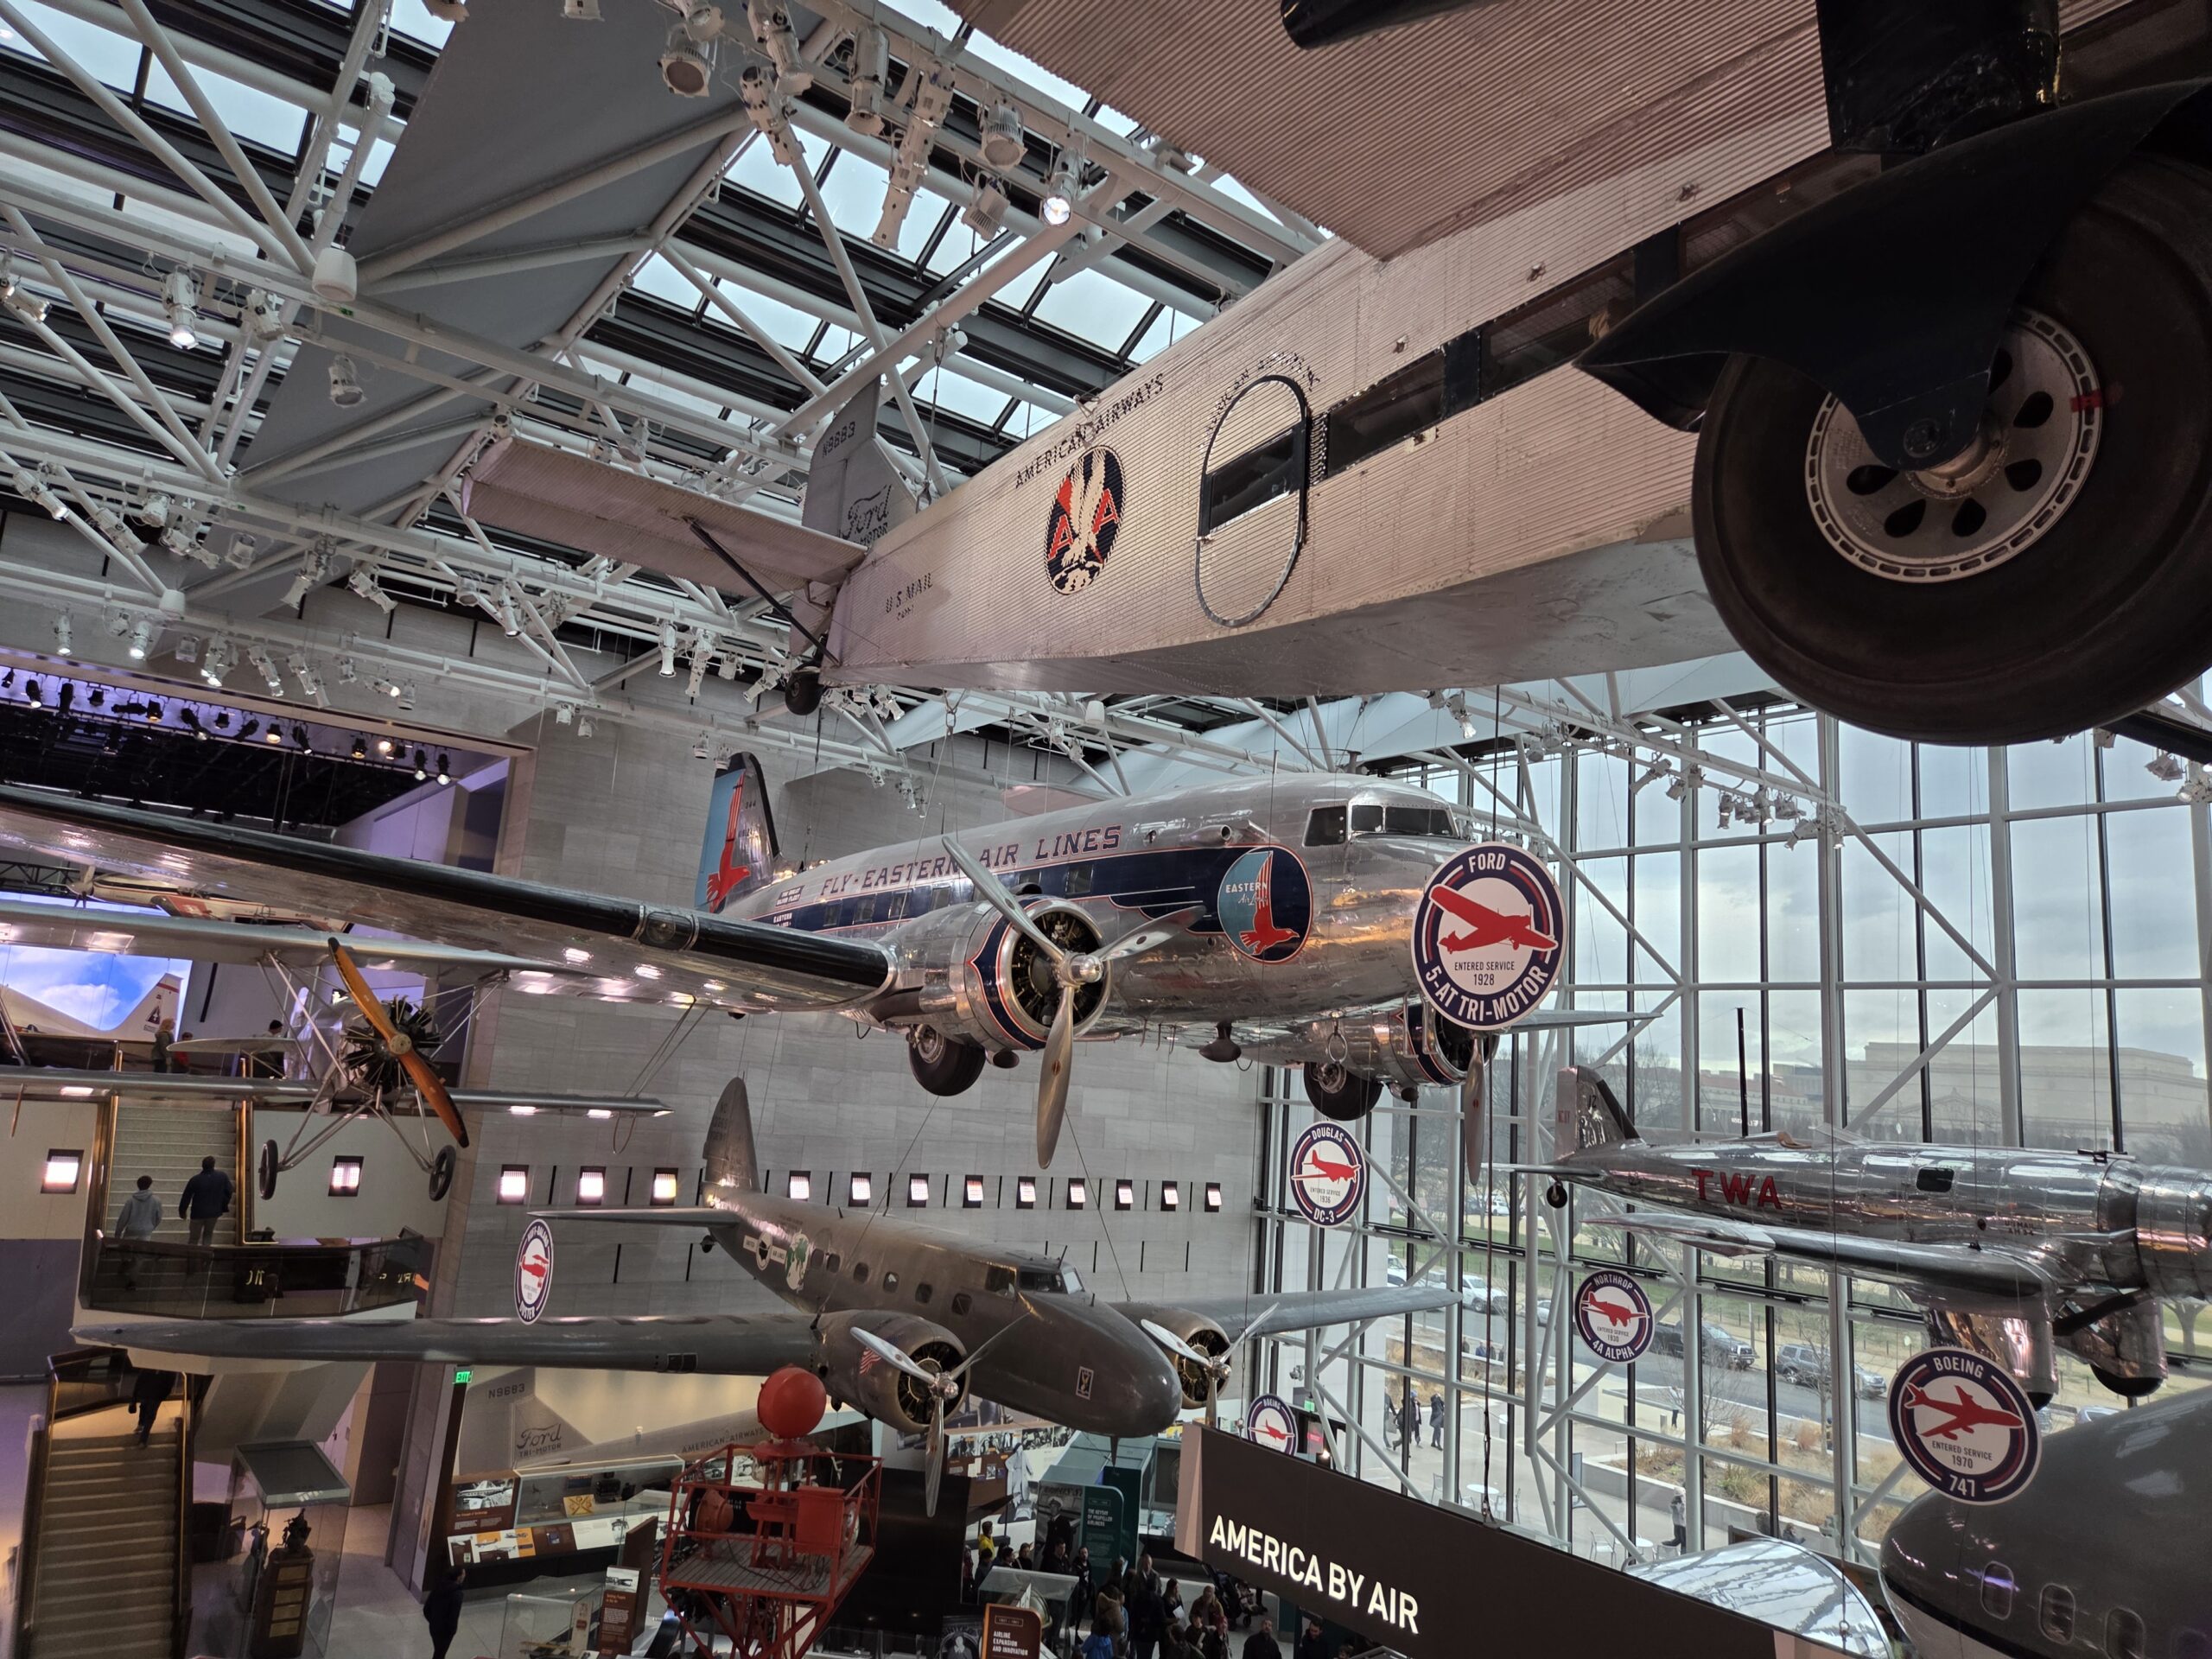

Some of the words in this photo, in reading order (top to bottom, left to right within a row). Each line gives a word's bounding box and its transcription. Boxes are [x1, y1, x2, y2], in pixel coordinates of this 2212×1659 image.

[822, 421, 855, 457] N9683
[1015, 426, 1081, 489] AMERICAN
[1095, 373, 1163, 433] AIRWAYS
[861, 854, 961, 889] EASTERN
[978, 842, 1020, 868] AIR
[1035, 824, 1122, 861] LINES
[1468, 852, 1506, 874] FORD
[1225, 882, 1268, 893] EASTERN
[1454, 962, 1484, 970] ENTERED
[1486, 961, 1516, 970] SERVICE
[1473, 974, 1495, 986] 1928
[1426, 965, 1459, 1007] 5-AT
[1458, 965, 1548, 1021] TRI-MOTOR
[1312, 1127, 1344, 1142] DOUGLAS
[1691, 1168, 1783, 1210] TWA
[1313, 1208, 1335, 1223] DC-3
[1593, 1274, 1633, 1290] NORTHROP
[1592, 1340, 1604, 1354] 4A
[1605, 1346, 1635, 1360] ALPHA
[1933, 1356, 1984, 1379] BOEING
[488, 1382, 525, 1399] N9683
[1263, 1398, 1281, 1410] BOEING
[517, 1422, 562, 1450] Ford
[682, 1437, 725, 1452] AMERICAN
[729, 1427, 764, 1441] AIRWAYS
[519, 1442, 562, 1458] TRI-MOTOR
[1932, 1440, 1961, 1454] ENTERED
[1964, 1447, 1993, 1460] SERVICE
[1952, 1454, 1974, 1469] 1970
[1948, 1474, 1976, 1497] 747
[1210, 1515, 1324, 1592] AMERICA
[1328, 1561, 1364, 1607] BY
[1367, 1581, 1419, 1635] AIR
